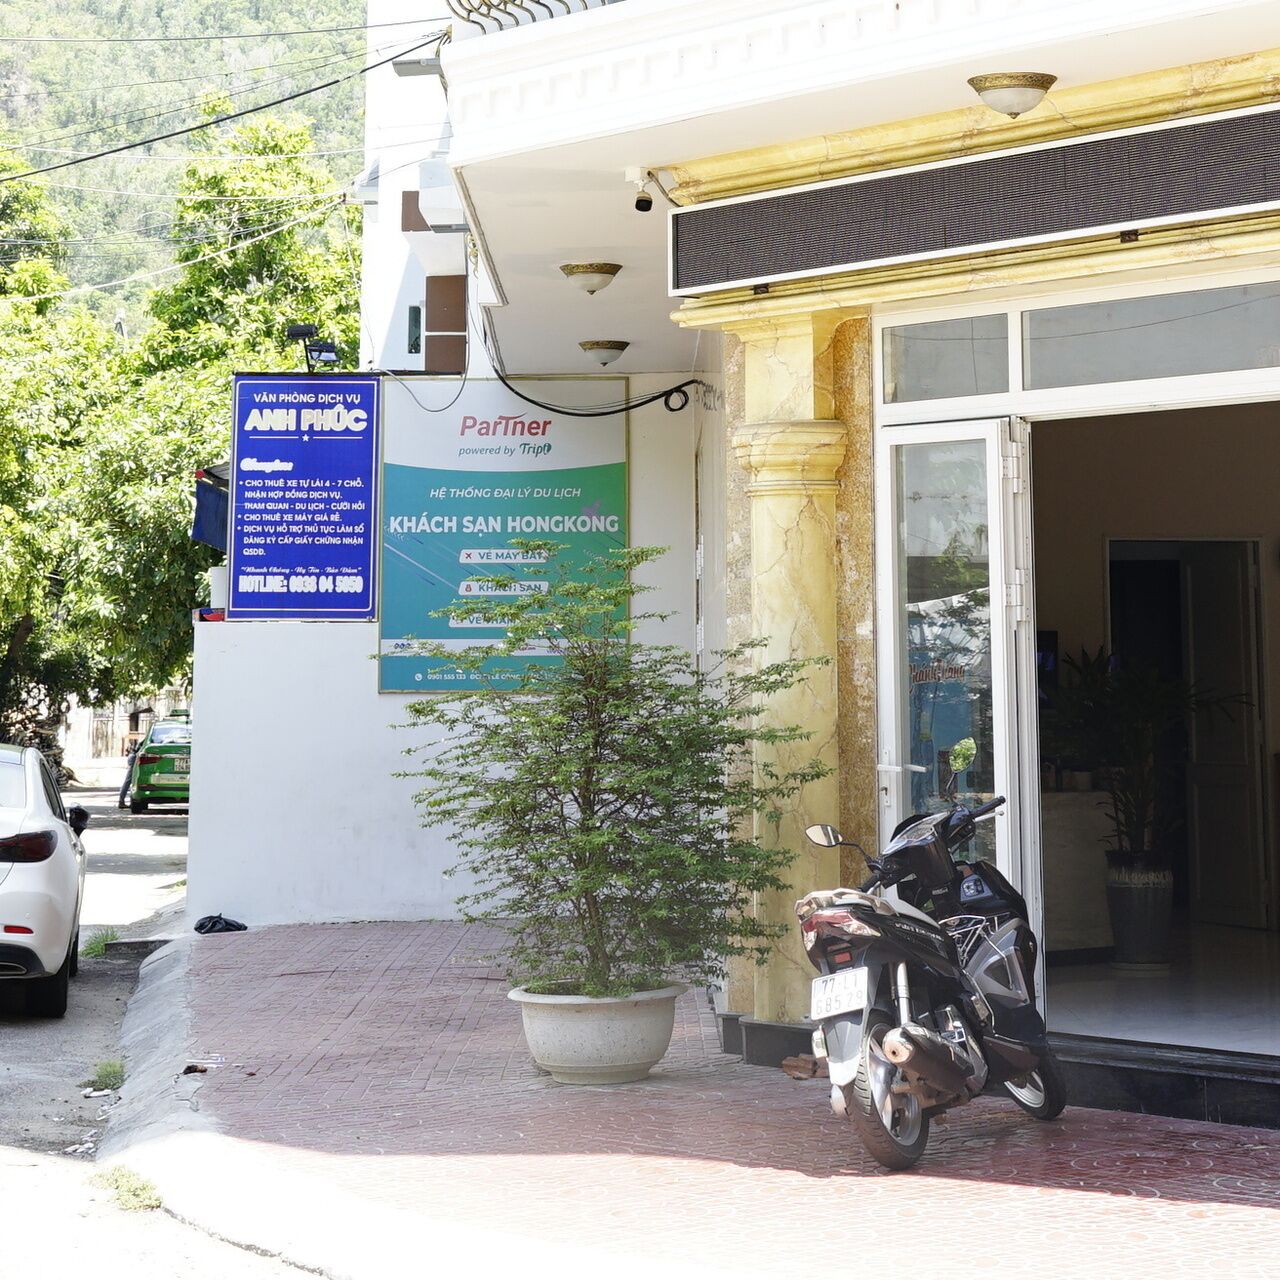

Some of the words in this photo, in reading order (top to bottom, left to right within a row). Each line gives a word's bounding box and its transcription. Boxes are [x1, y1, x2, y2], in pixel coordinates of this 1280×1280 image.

[254, 391, 276, 402] VĂN
[279, 391, 315, 403] PHÒNG
[318, 393, 343, 404] DỊCH
[345, 393, 361, 404] VỤ
[244, 408, 297, 431] ANH
[458, 445, 501, 457] powered
[503, 445, 515, 457] by
[264, 478, 286, 487] THUÊ
[287, 479, 299, 487] XE
[299, 479, 311, 488] TỰ
[311, 478, 324, 487] LÁI
[244, 490, 267, 500] NHẬN
[268, 491, 283, 500] HỢP
[309, 491, 328, 499] DỊCH
[429, 487, 447, 499] HỆ
[448, 484, 491, 498] THỐNG
[493, 487, 514, 500] ĐẠI
[517, 486, 532, 498] LÝ
[534, 487, 552, 498] DU
[554, 487, 581, 499] LỊCH
[244, 502, 266, 510] THAM
[266, 502, 289, 510] QUAN
[295, 502, 307, 510] DU
[308, 502, 325, 511] LỊCH
[262, 512, 281, 521] THUÊ
[294, 512, 312, 521] MÁY
[314, 512, 329, 521] GIÁ
[243, 525, 262, 534] DỊCH
[263, 525, 275, 534] VỤ
[289, 525, 304, 534] TRỢ
[320, 525, 336, 534] TỤC
[336, 523, 353, 533] LÀM
[389, 512, 457, 534] KHÁCH
[462, 516, 502, 537] SẠN
[507, 515, 619, 534] HONGKONG
[277, 535, 294, 544] CẤP
[294, 535, 314, 544] GIẤY
[342, 535, 364, 546] NHẬN
[238, 575, 288, 593] HOTLINE:
[318, 575, 334, 593] 04
